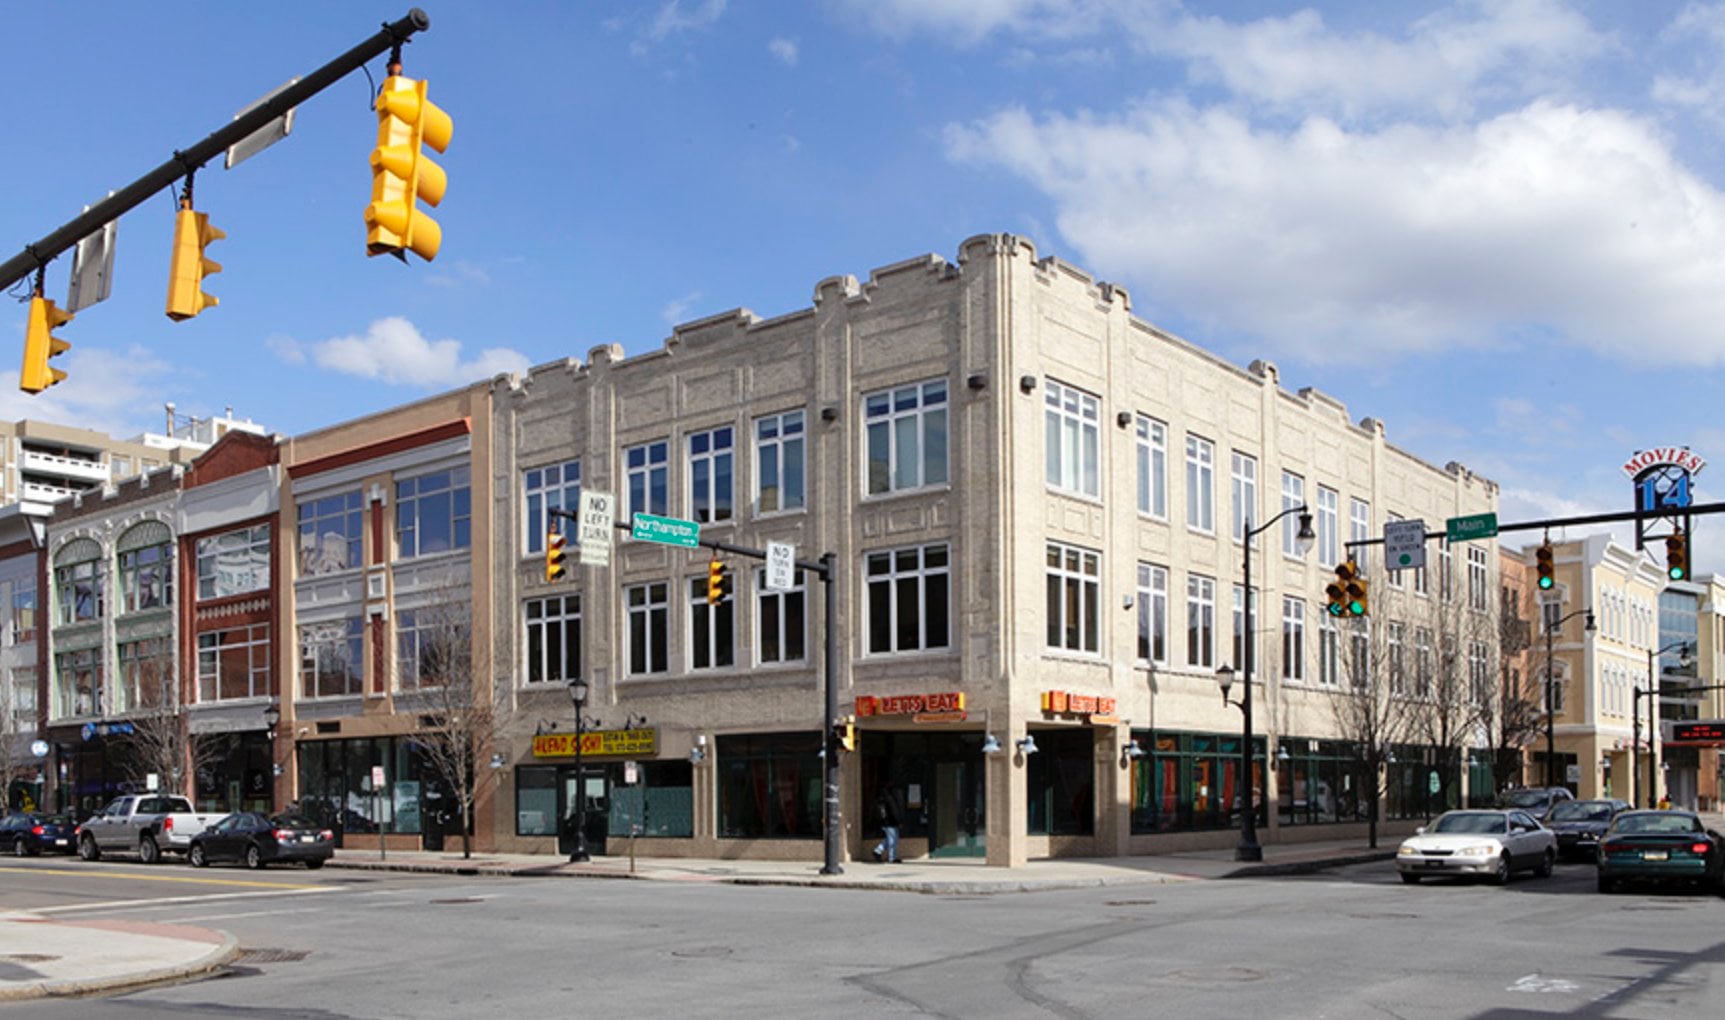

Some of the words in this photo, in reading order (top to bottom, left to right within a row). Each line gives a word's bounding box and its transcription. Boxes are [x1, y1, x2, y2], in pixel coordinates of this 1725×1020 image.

[1623, 447, 1702, 476] MOVIES
[1637, 475, 1690, 512] 14
[589, 497, 607, 512] NO
[584, 513, 610, 526] LEFT
[635, 517, 694, 537] Northampton
[1456, 520, 1486, 532] Main
[583, 526, 610, 539] TURN
[773, 547, 789, 558] NO
[926, 691, 955, 711] EAT
